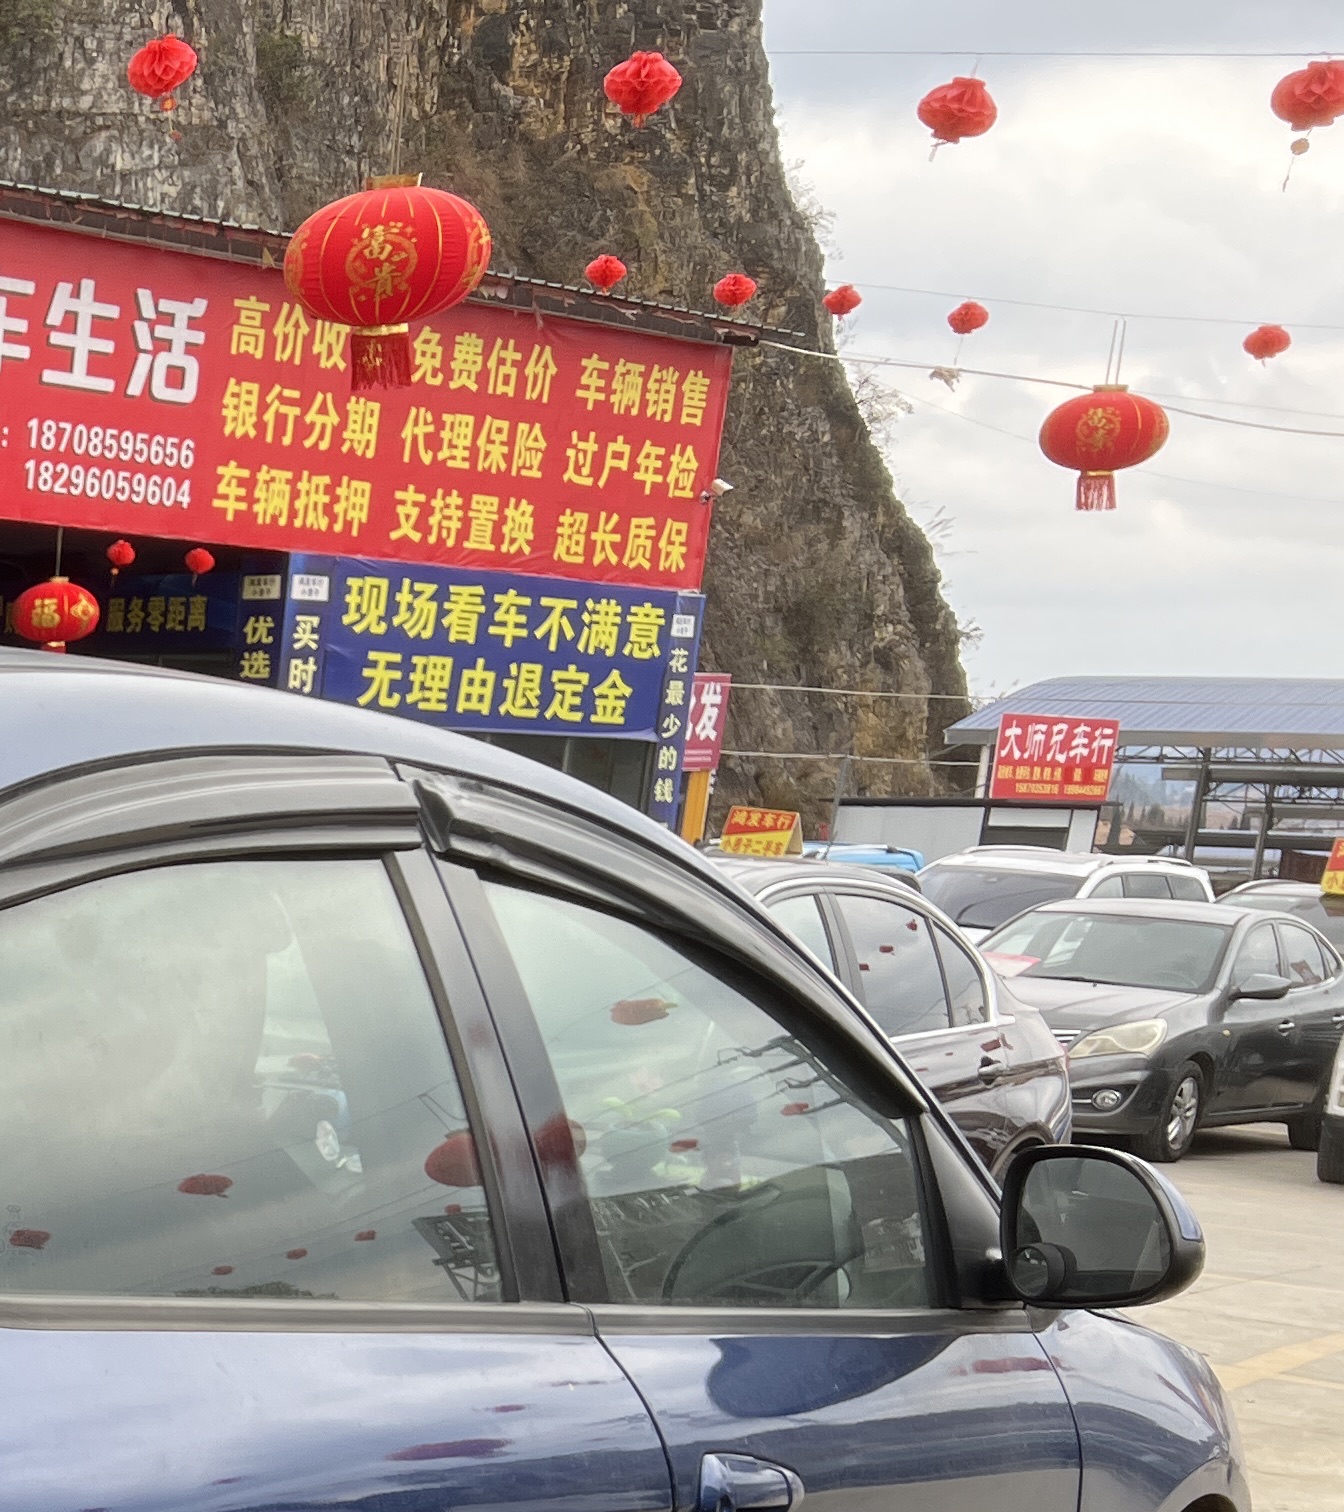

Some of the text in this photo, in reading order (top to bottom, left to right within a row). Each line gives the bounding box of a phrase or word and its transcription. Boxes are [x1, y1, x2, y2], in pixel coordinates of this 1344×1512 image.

[229, 294, 711, 427] 高价收 免费估价 车辆销售
[26, 416, 195, 470] 18708595656
[220, 376, 700, 500] 银行分期 代理保险 过户年检
[23, 458, 192, 510] 18296059604
[211, 459, 689, 574] 车辆抵押 支持置换 超长质保
[238, 614, 276, 679] 优选
[287, 614, 322, 694] 买时
[340, 574, 667, 660] 现场看车不满意
[355, 649, 634, 726] 无理由退定金
[653, 647, 689, 830] 花最少的钱
[999, 719, 1115, 765] 大师兄车行
